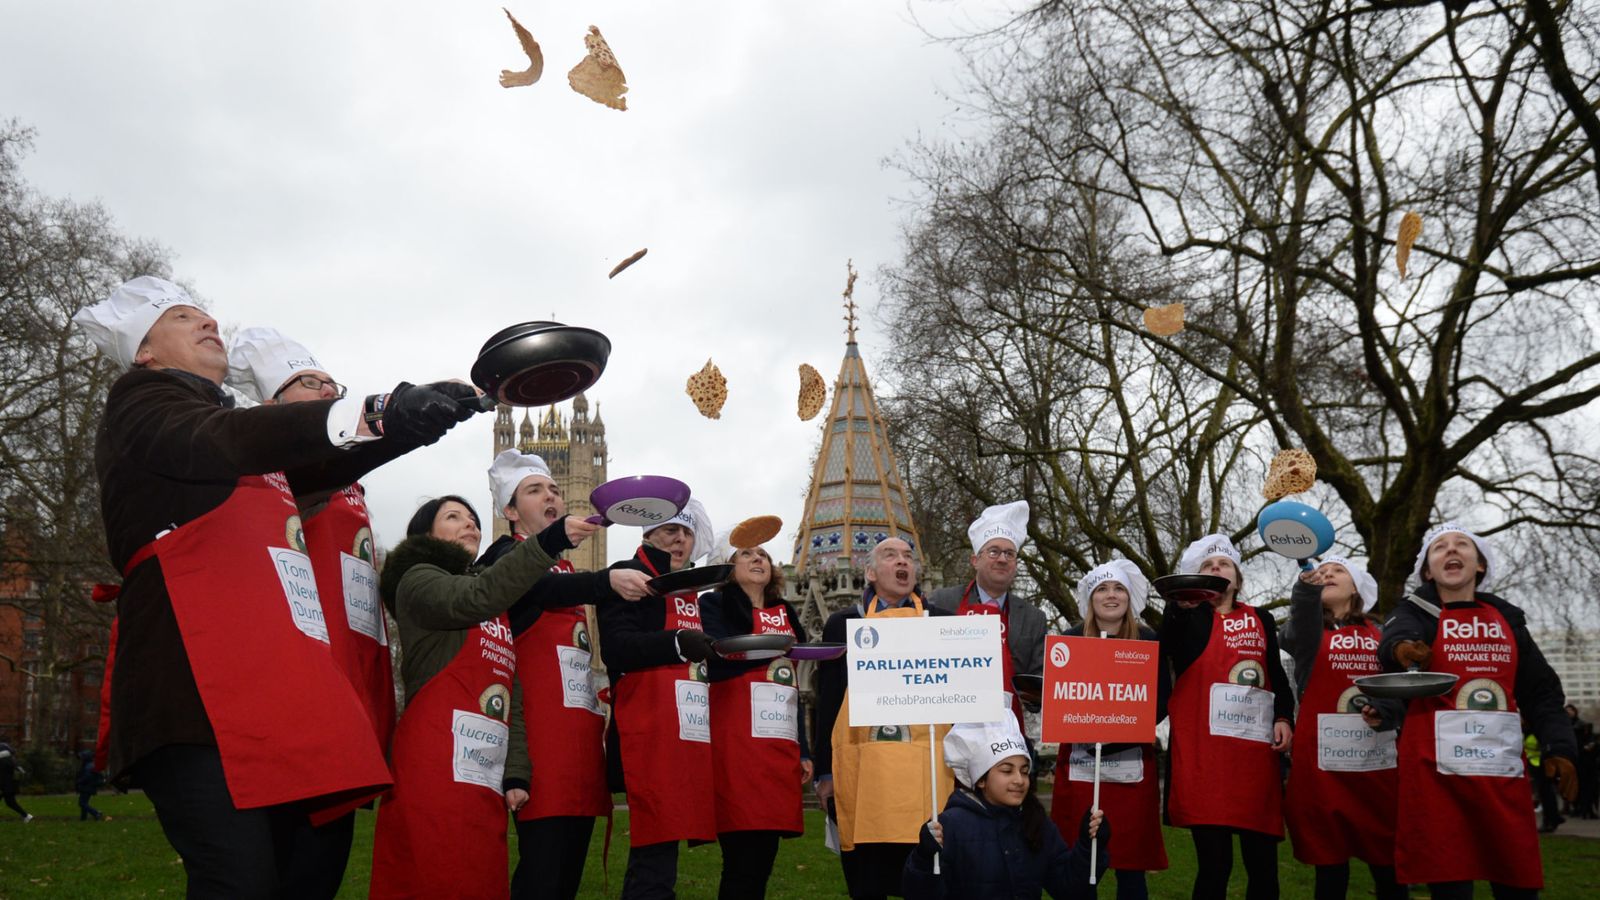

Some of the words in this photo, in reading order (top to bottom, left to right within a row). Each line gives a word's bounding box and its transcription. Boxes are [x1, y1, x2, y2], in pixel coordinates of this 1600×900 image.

[616, 504, 663, 520] Rehab
[1270, 533, 1312, 545] Rehab
[279, 560, 310, 580] Tom
[940, 627, 988, 637] RehabGroup
[1114, 650, 1150, 661] RehabGroup
[1448, 653, 1489, 662] PANCAKE
[856, 657, 993, 671] PARLIAMENTARY
[1331, 662, 1367, 670] PANCAKE
[902, 673, 948, 685] TEAM
[773, 692, 786, 702] Jo
[1053, 682, 1104, 700] MEDIA
[1107, 683, 1148, 702] TEAM
[1225, 691, 1252, 704] Laura
[876, 693, 977, 706] #RehabPancakeRace
[1063, 713, 1138, 725] #RehabPancakeRace
[1218, 710, 1257, 724] Hughes
[1323, 727, 1374, 740] Georgie
[1464, 721, 1486, 734] Liz
[1454, 744, 1496, 759] Bates
